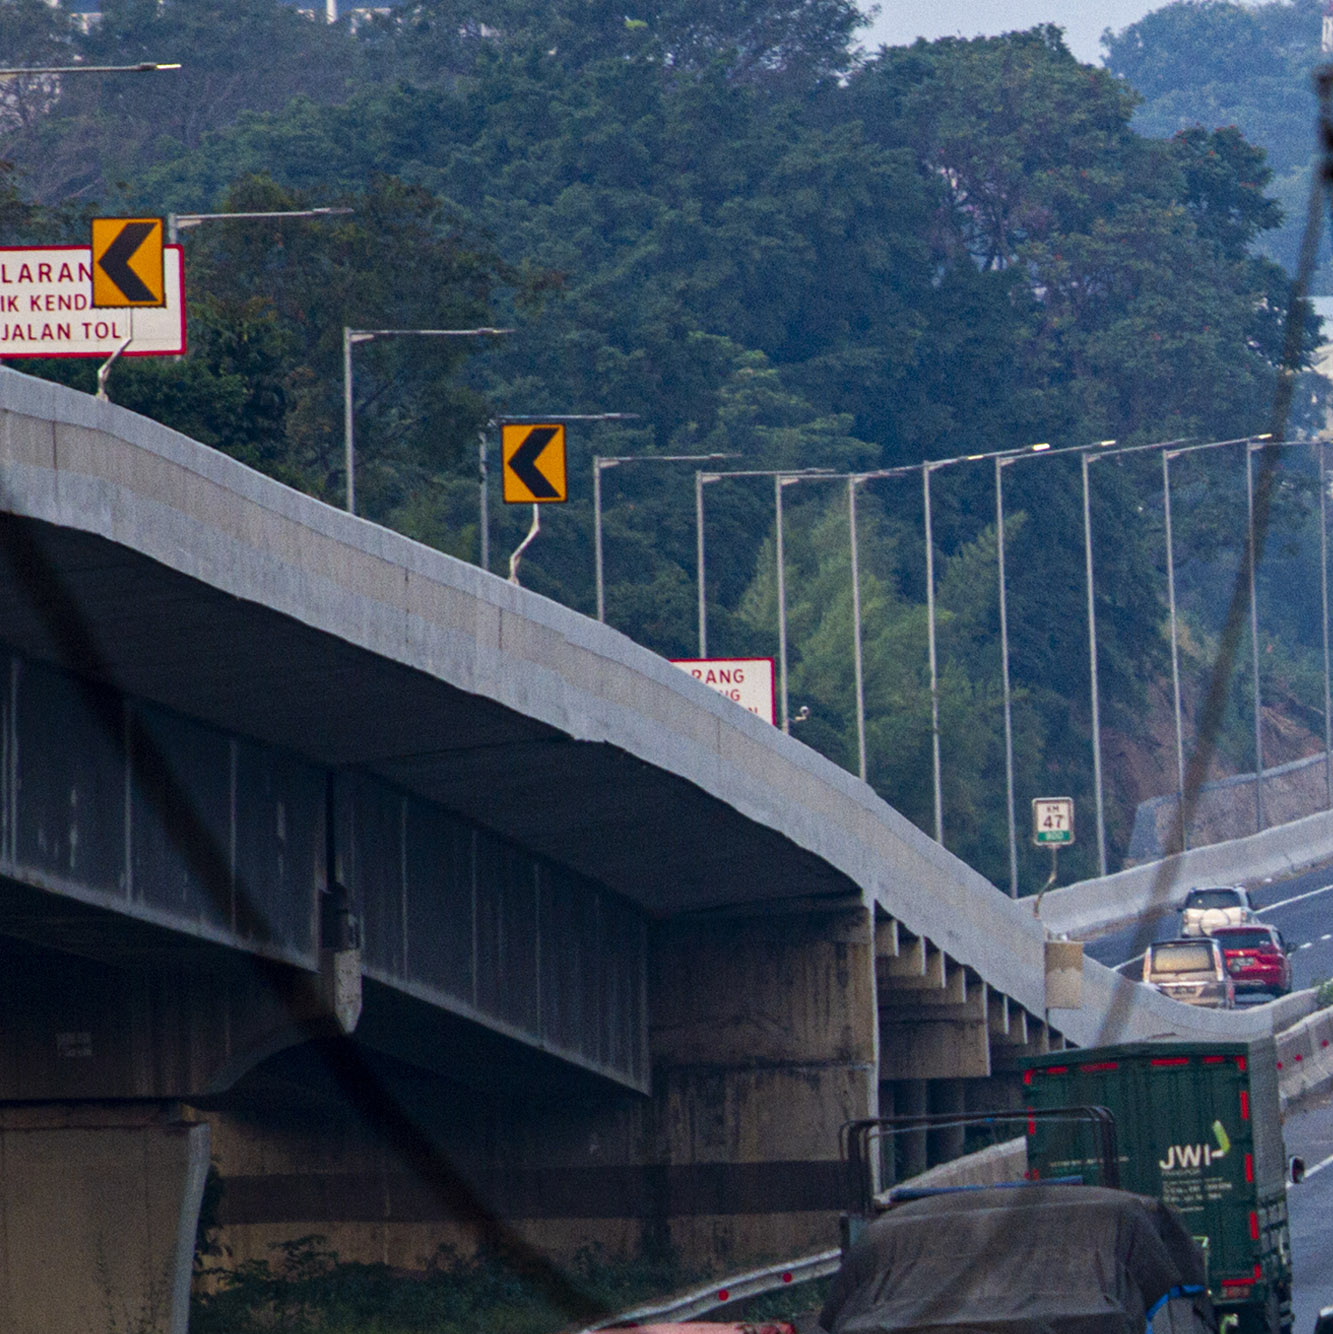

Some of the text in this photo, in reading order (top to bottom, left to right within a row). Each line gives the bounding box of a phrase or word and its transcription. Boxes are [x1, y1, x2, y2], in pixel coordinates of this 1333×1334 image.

[30, 294, 92, 312] KEND
[1, 322, 121, 340] JALAN TOL
[1043, 815, 1065, 828] 47
[1159, 1143, 1210, 1170] JWI
